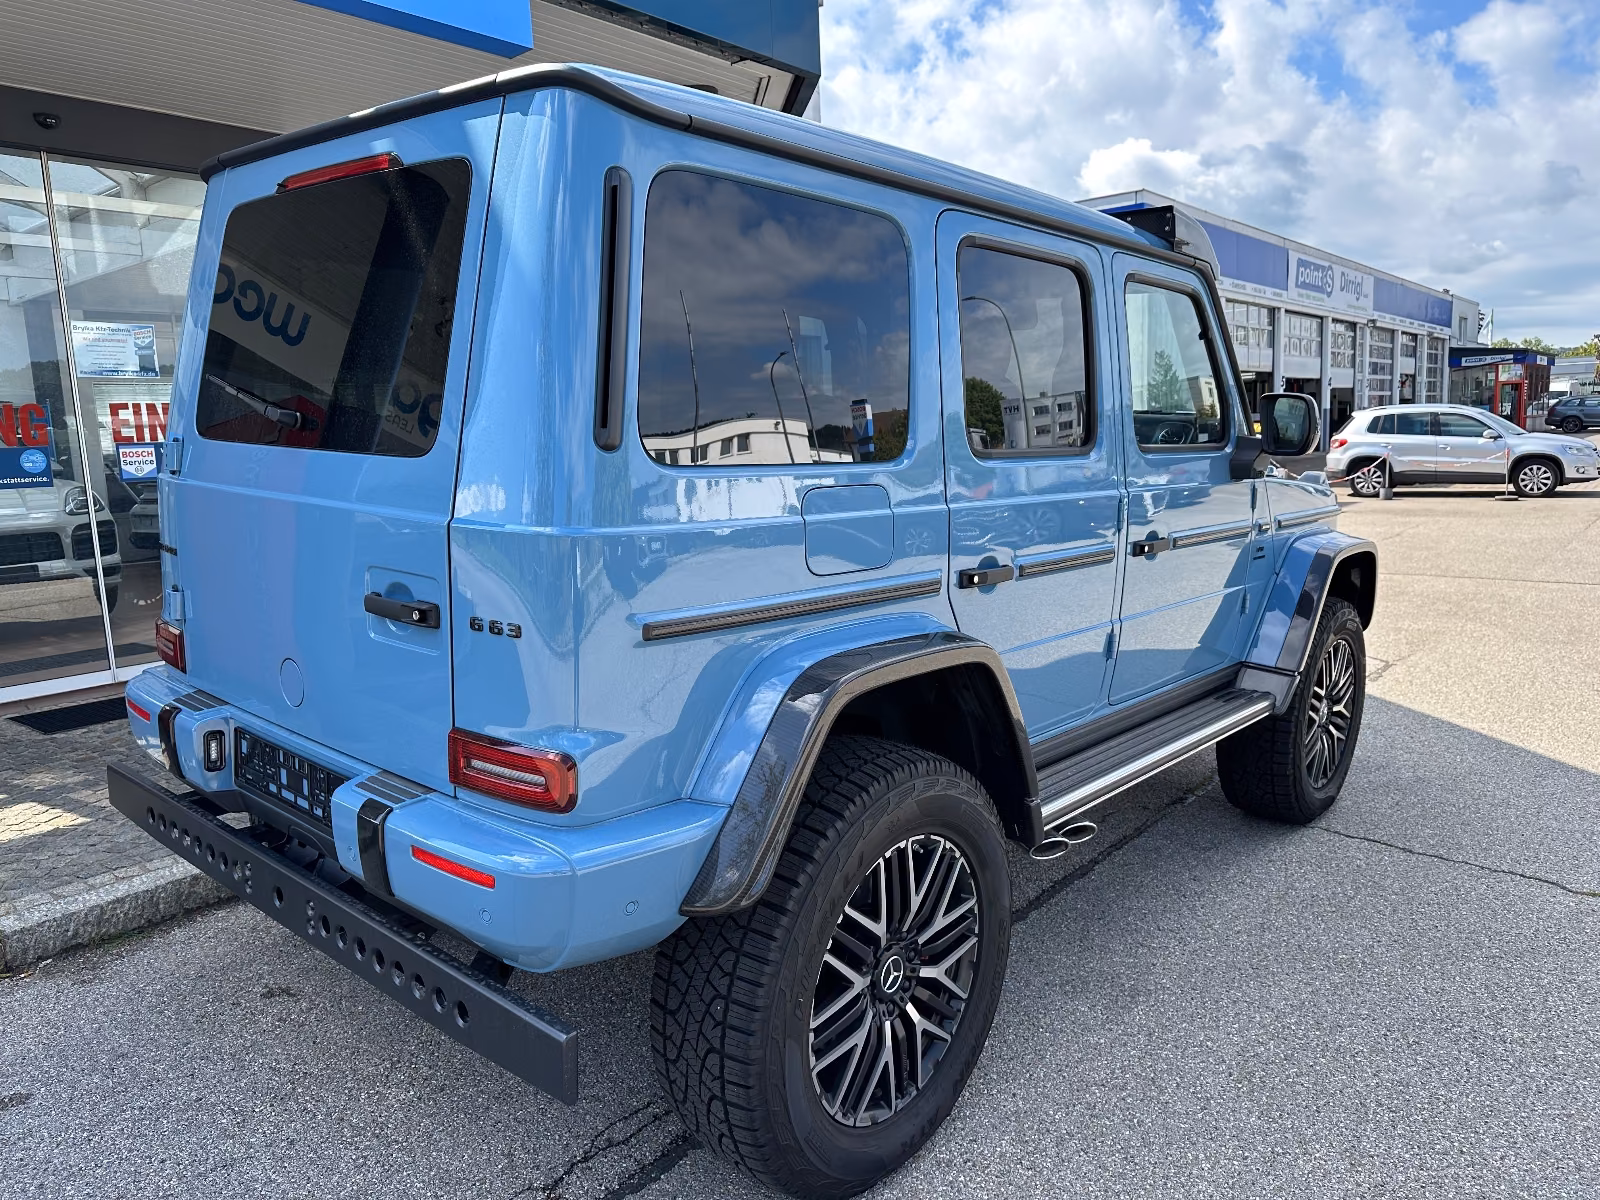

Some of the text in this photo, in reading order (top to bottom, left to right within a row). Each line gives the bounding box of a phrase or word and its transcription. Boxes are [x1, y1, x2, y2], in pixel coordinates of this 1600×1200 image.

[1297, 265, 1323, 287] point
[1339, 271, 1364, 302] Dirrigl
[1280, 376, 1285, 387] 5
[109, 402, 169, 443] EIN
[121, 450, 154, 458] BOSCH
[122, 458, 155, 466] Service
